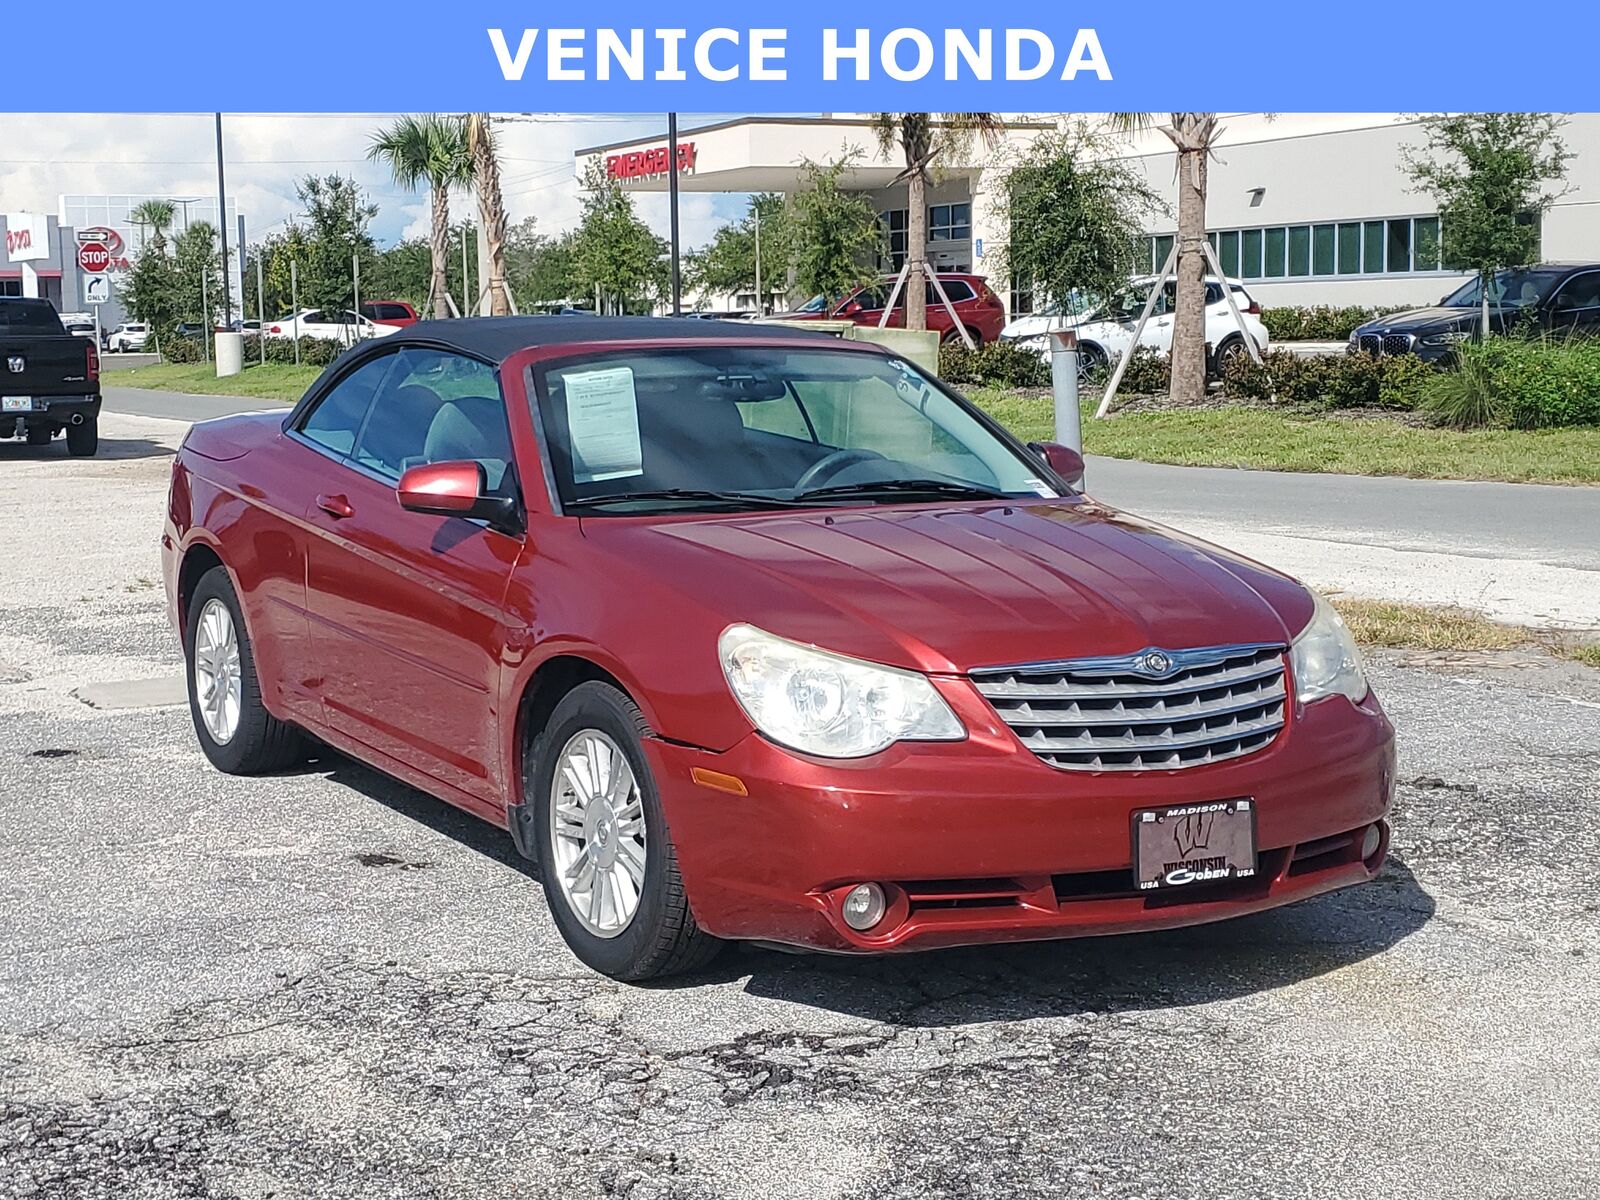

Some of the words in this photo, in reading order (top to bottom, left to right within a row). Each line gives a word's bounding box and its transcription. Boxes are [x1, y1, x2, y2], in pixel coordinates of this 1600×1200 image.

[81, 251, 108, 264] STOP
[1166, 803, 1228, 817] MADISON
[1162, 856, 1227, 874] WISCONSIN
[1140, 880, 1159, 889] USA
[1236, 868, 1255, 877] USA
